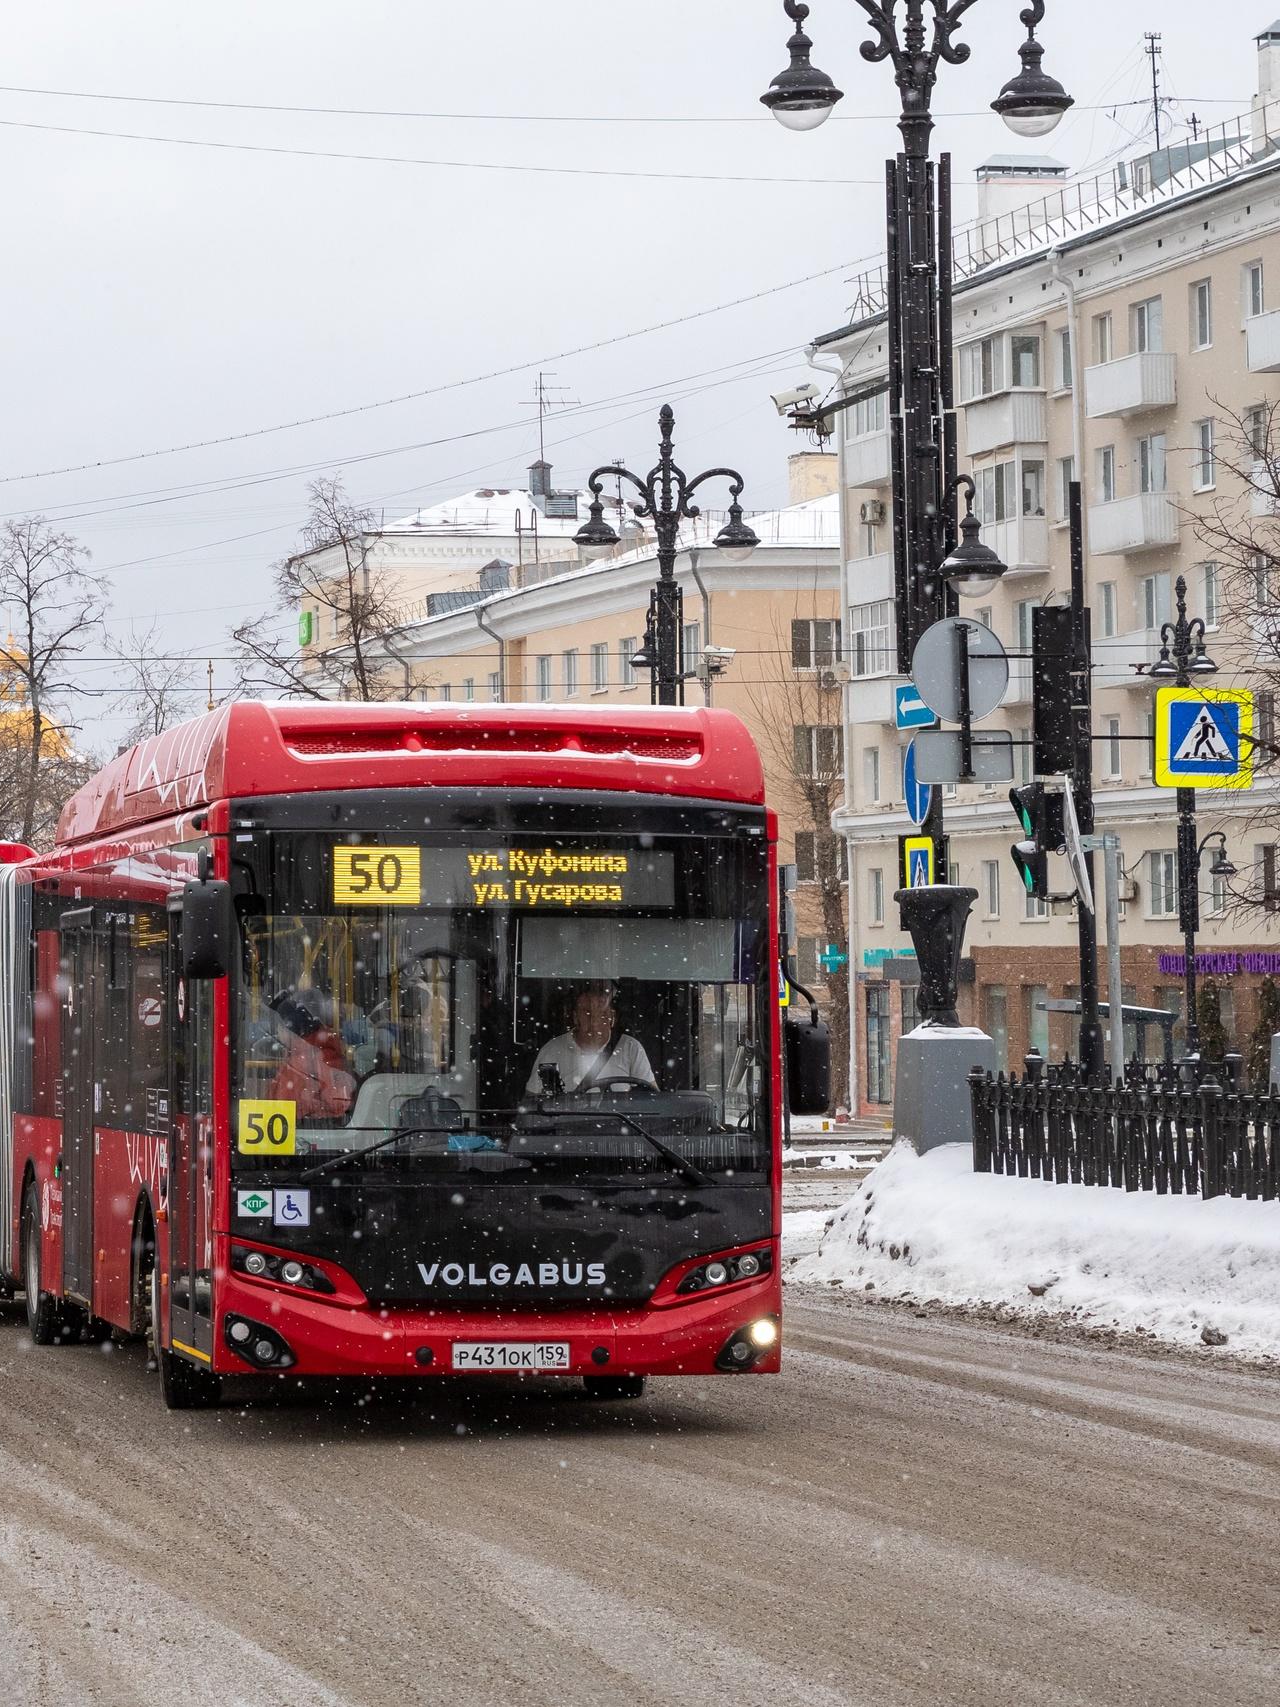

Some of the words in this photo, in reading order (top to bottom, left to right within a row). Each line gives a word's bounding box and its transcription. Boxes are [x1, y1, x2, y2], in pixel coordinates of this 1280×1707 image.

[349, 853, 402, 893] 50
[467, 853, 503, 876] ул.
[509, 849, 627, 876] Куфонина
[473, 883, 509, 905] ул.
[514, 880, 622, 905] Гусарова
[245, 1113, 289, 1145] 50
[246, 1200, 265, 1208] КПГ
[417, 1263, 606, 1286] VOLGABUS
[536, 1346, 564, 1361] 159
